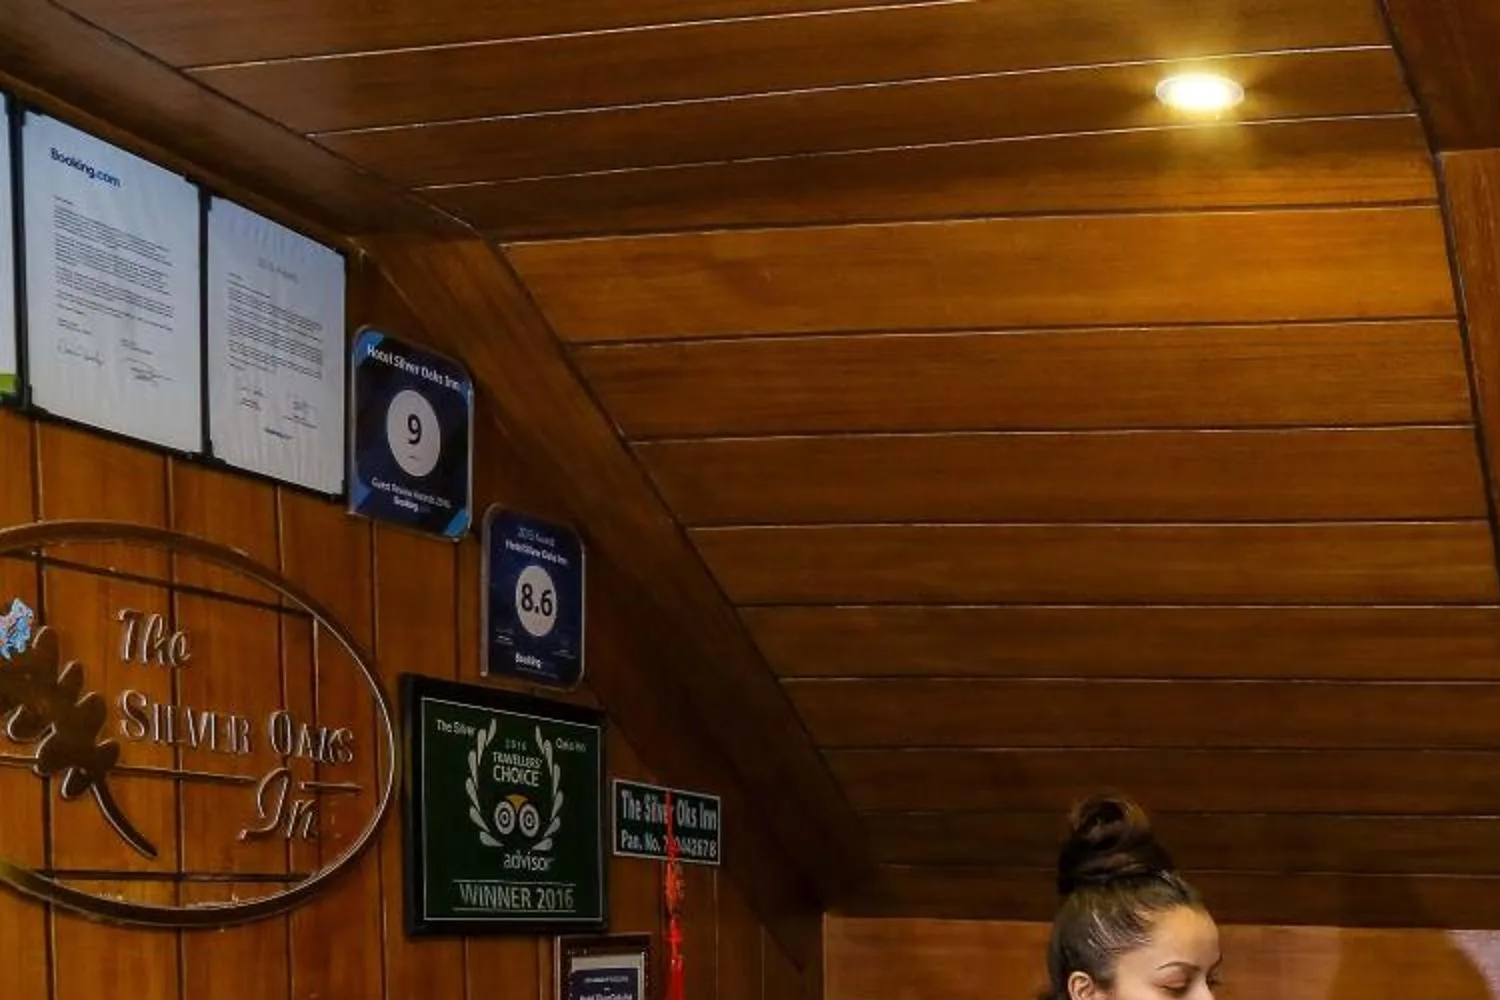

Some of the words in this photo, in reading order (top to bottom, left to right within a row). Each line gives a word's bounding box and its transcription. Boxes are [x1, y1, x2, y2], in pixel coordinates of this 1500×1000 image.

[50, 147, 121, 188] Booking.com
[367, 343, 393, 365] Hotel
[407, 413, 422, 446] 9
[521, 583, 553, 617] 8.6
[115, 606, 192, 667] The
[119, 689, 254, 756] SILVER
[268, 709, 356, 765] OAKS
[493, 765, 541, 788] CHOICE
[621, 789, 642, 821] The
[699, 802, 717, 832] Inn
[503, 849, 552, 873] advisor
[460, 883, 532, 910] WINNER
[537, 886, 575, 911] 2016
